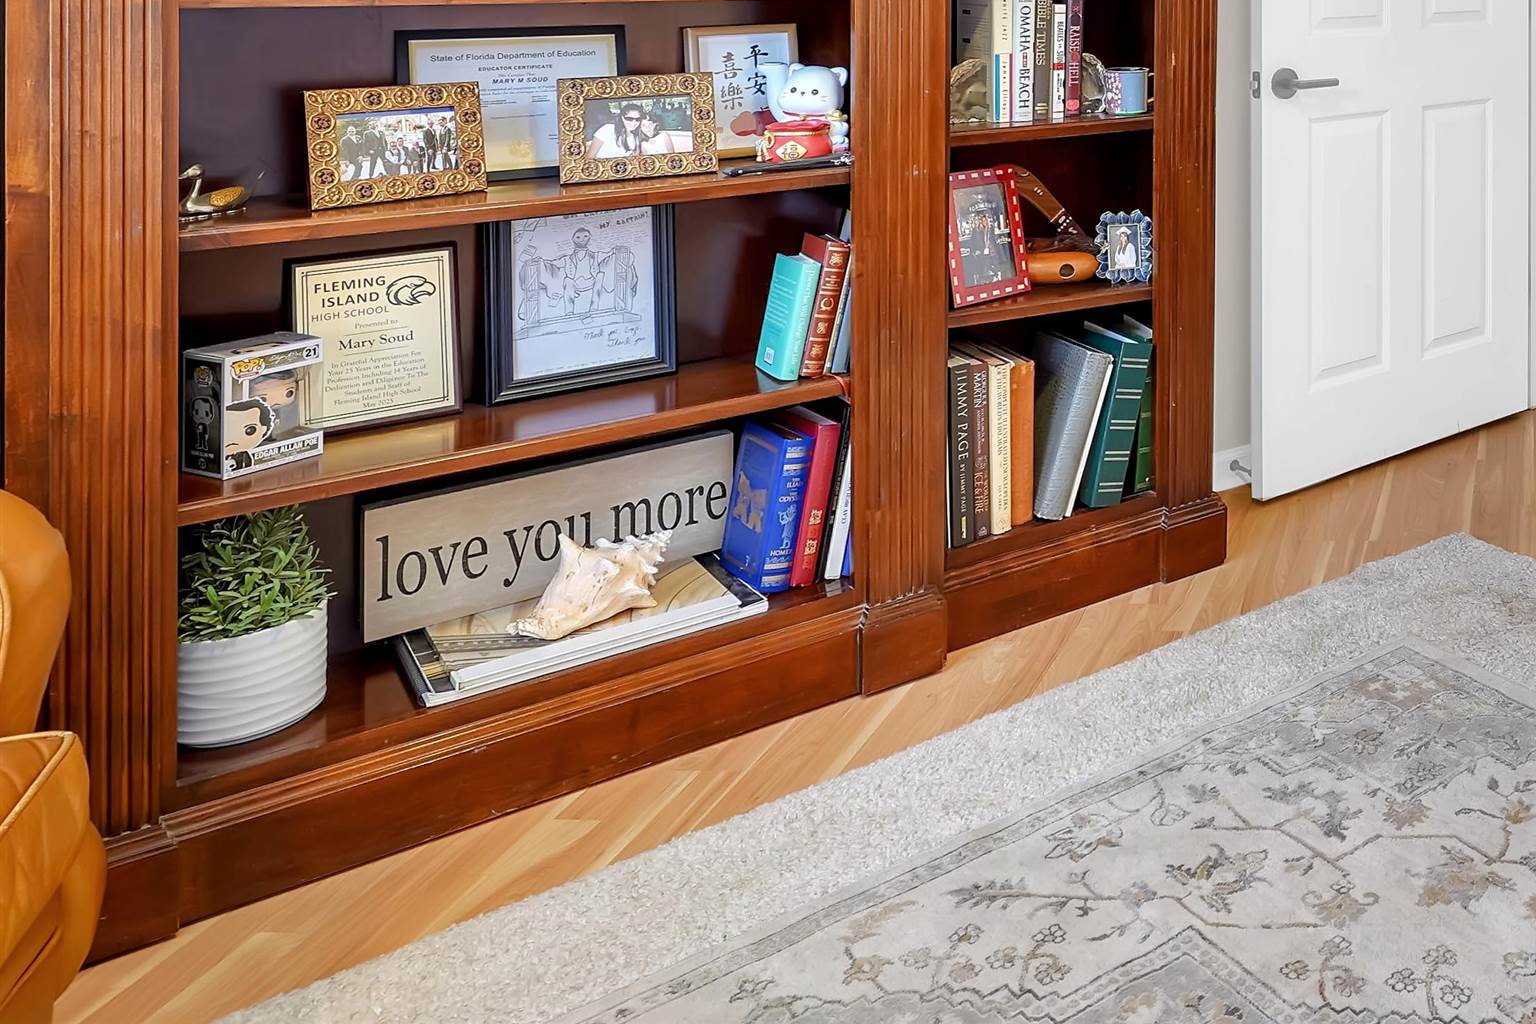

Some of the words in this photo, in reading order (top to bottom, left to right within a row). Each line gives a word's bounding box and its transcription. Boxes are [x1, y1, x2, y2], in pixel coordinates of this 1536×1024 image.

[1019, 5, 1032, 53] OMAHA
[1056, 21, 1064, 42] BEATLES
[1068, 25, 1080, 52] RAISE
[430, 53, 454, 63] State
[455, 52, 464, 62] of
[466, 52, 495, 61] Florida
[497, 50, 547, 62] Department
[548, 50, 556, 58] of
[556, 48, 596, 58] Education
[1036, 31, 1047, 66] TIMES
[744, 44, 769, 96] 平安
[1068, 62, 1080, 87] HELL
[1018, 68, 1031, 109] BEACH
[781, 144, 800, 160] 福
[314, 275, 386, 294] FLEMING
[322, 291, 380, 308] ISLAND
[311, 312, 341, 323] HIGH
[343, 305, 390, 319] SCHOOL
[354, 319, 389, 330] Presented
[338, 338, 376, 352] Mary
[379, 330, 414, 345] Soud
[305, 347, 317, 357] 21
[231, 357, 264, 376] POP!
[955, 369, 968, 417] JIMMY
[973, 372, 982, 408] MARTIN
[254, 447, 280, 460] EDGAR
[280, 440, 303, 453] ALLAN
[304, 436, 318, 448] POE
[957, 423, 969, 461] PAGE
[974, 472, 983, 487] ICE
[975, 487, 983, 495] &
[974, 495, 984, 514] FIRE
[375, 535, 489, 602] love
[503, 511, 594, 589] you
[610, 481, 728, 544] more
